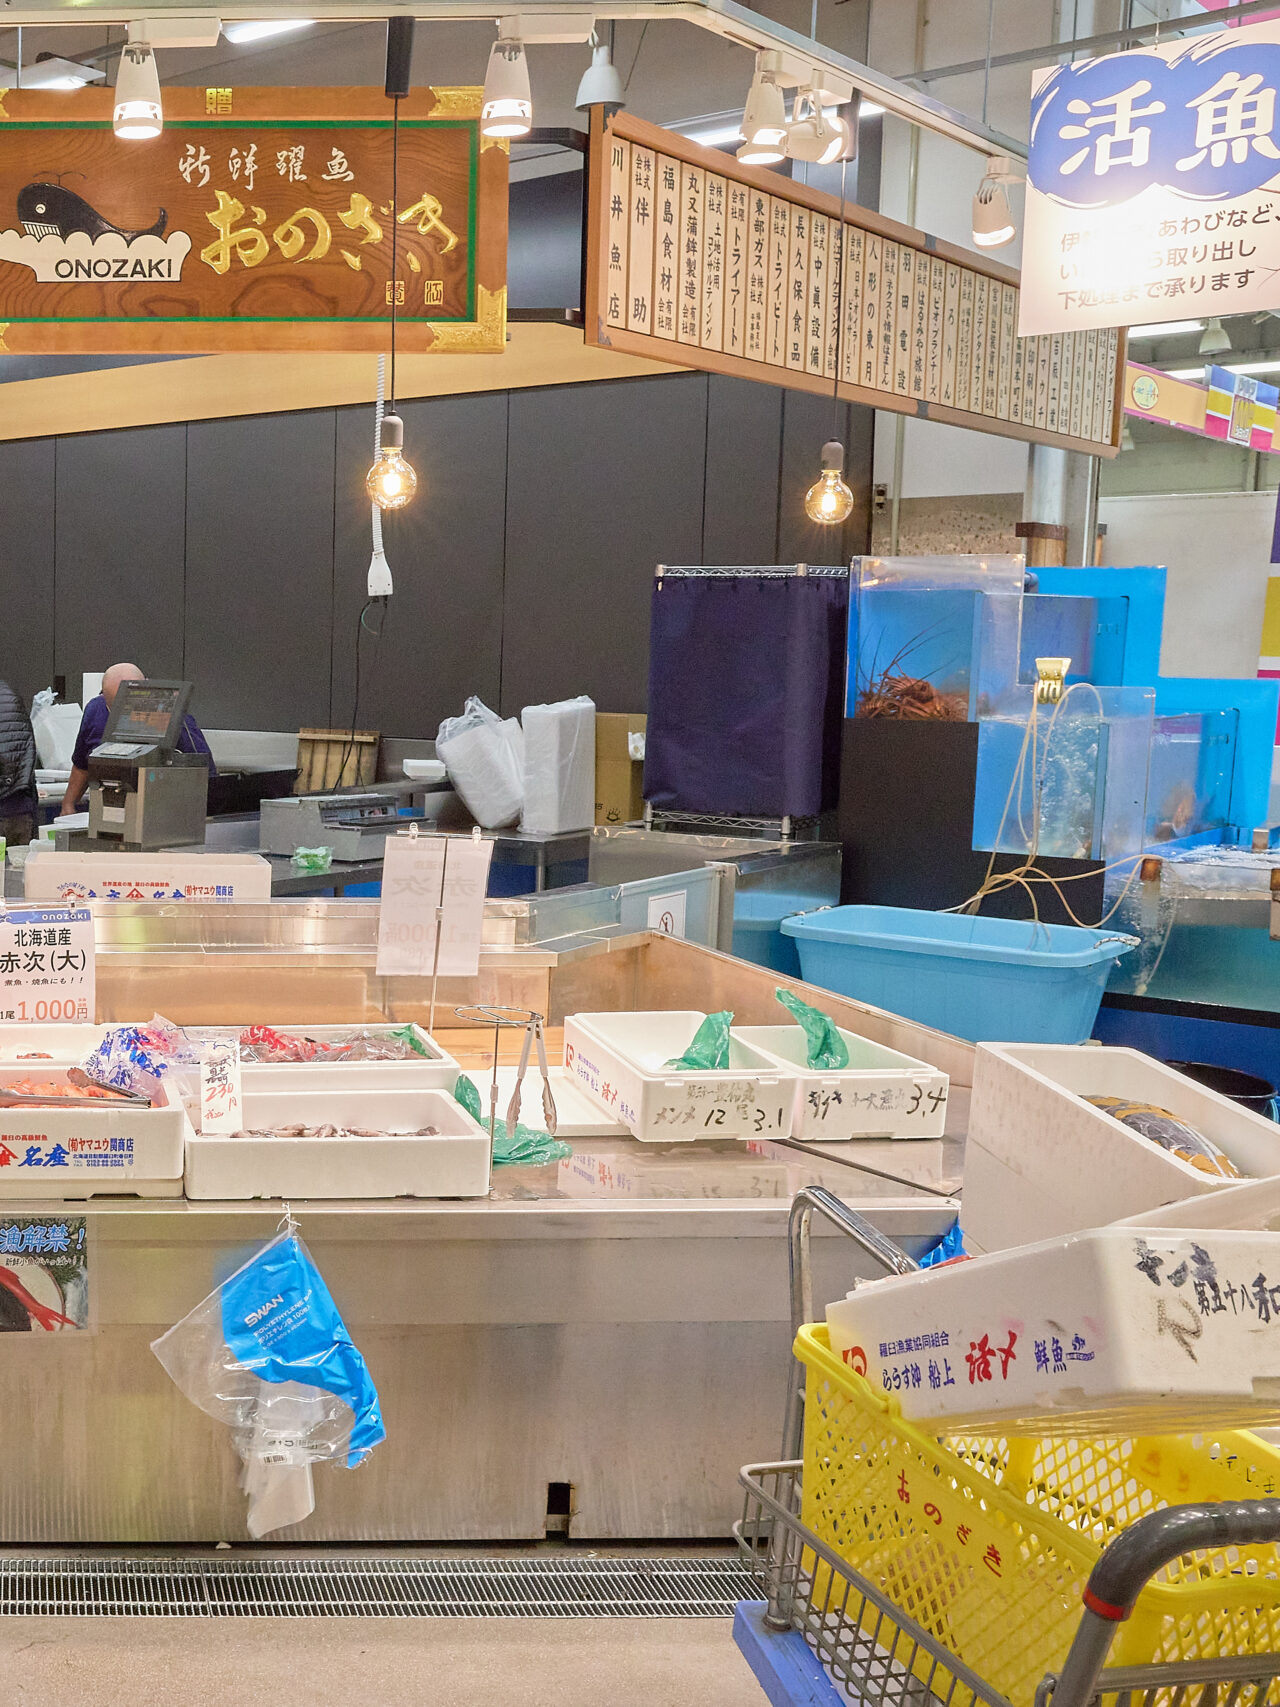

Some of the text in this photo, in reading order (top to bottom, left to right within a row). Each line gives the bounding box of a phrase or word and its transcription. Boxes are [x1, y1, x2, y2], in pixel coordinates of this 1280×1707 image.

[1059, 71, 1280, 176] 活魚
[200, 190, 460, 275] おのざき
[660, 165, 675, 293] 福島食材
[684, 172, 700, 300] 丸又蒲鉾製造
[754, 197, 765, 269] 東部ガス
[54, 257, 173, 279] ONOZAKI
[731, 226, 741, 348] トライアート
[791, 215, 805, 362] 長久保食品
[773, 241, 783, 358] トライビート
[865, 241, 878, 383] 人形の東月
[0, 949, 86, 973] 赤次(大)
[14, 928, 71, 947] 北海道産
[704, 1109, 726, 1126] 12
[754, 1108, 783, 1131] 3.1
[17, 1143, 70, 1167] 名産
[244, 1294, 284, 1327] SWAN
[879, 1331, 950, 1358] 羅臼漁業協同組合
[1034, 1336, 1067, 1374] 鮮魚
[928, 1357, 956, 1390] 船上
